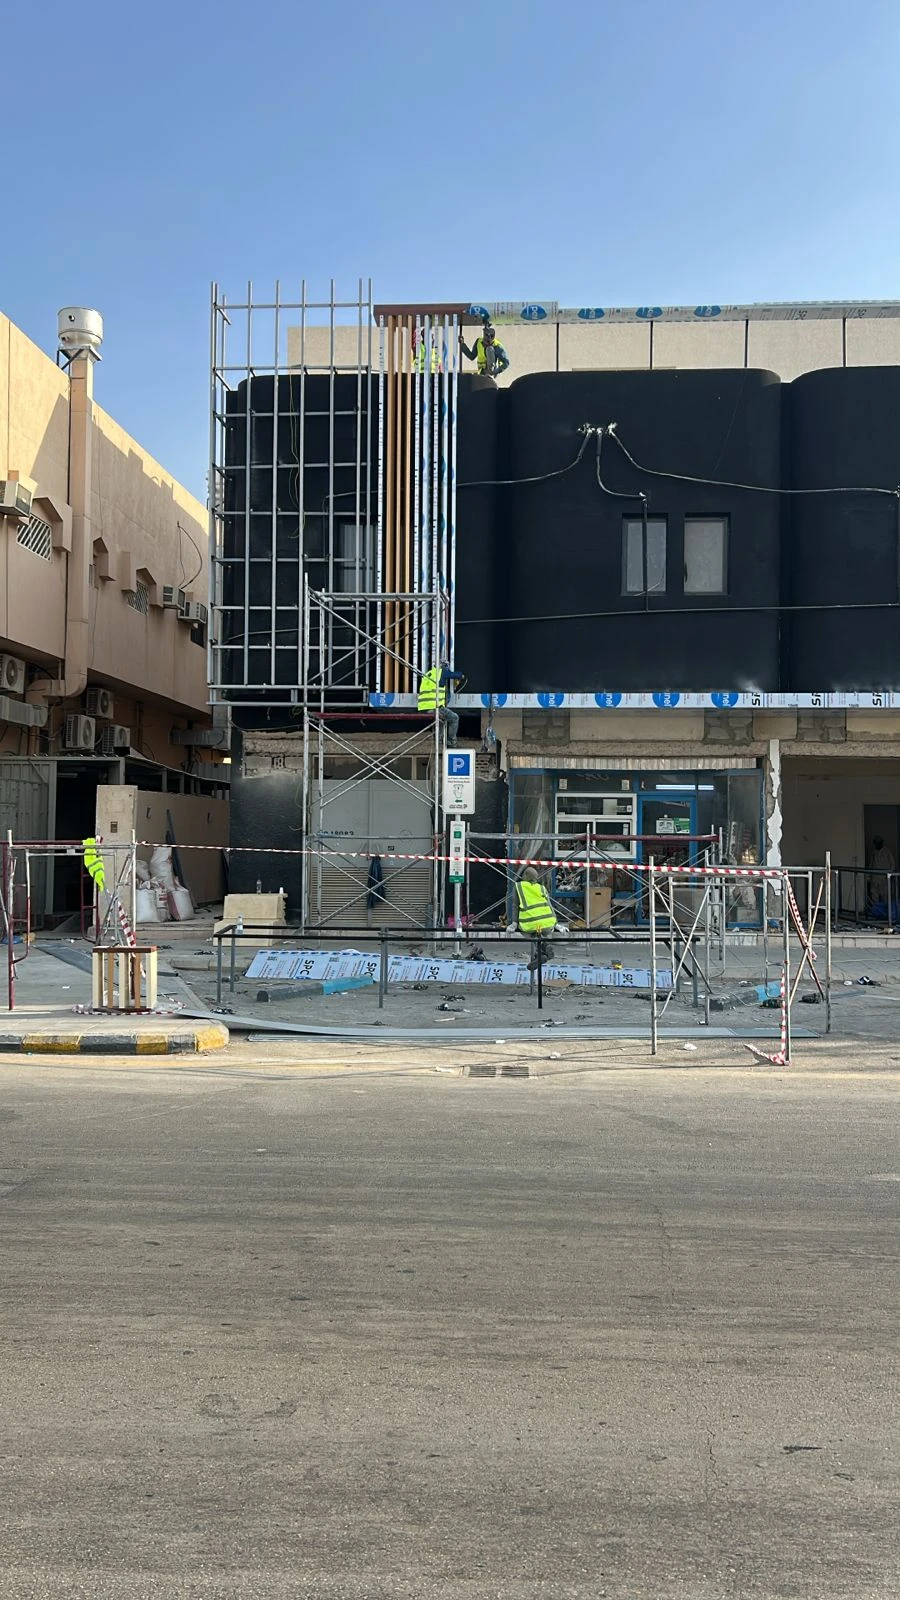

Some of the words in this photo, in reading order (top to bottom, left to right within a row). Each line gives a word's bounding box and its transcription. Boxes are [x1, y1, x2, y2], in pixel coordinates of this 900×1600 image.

[548, 693, 557, 707] nel
[606, 693, 614, 707] nel
[664, 692, 672, 707] nel
[722, 692, 730, 707] nel
[453, 757, 465, 773] P
[300, 959, 314, 975] SPC
[427, 966, 439, 980] SPC
[491, 968, 503, 981] SPC
